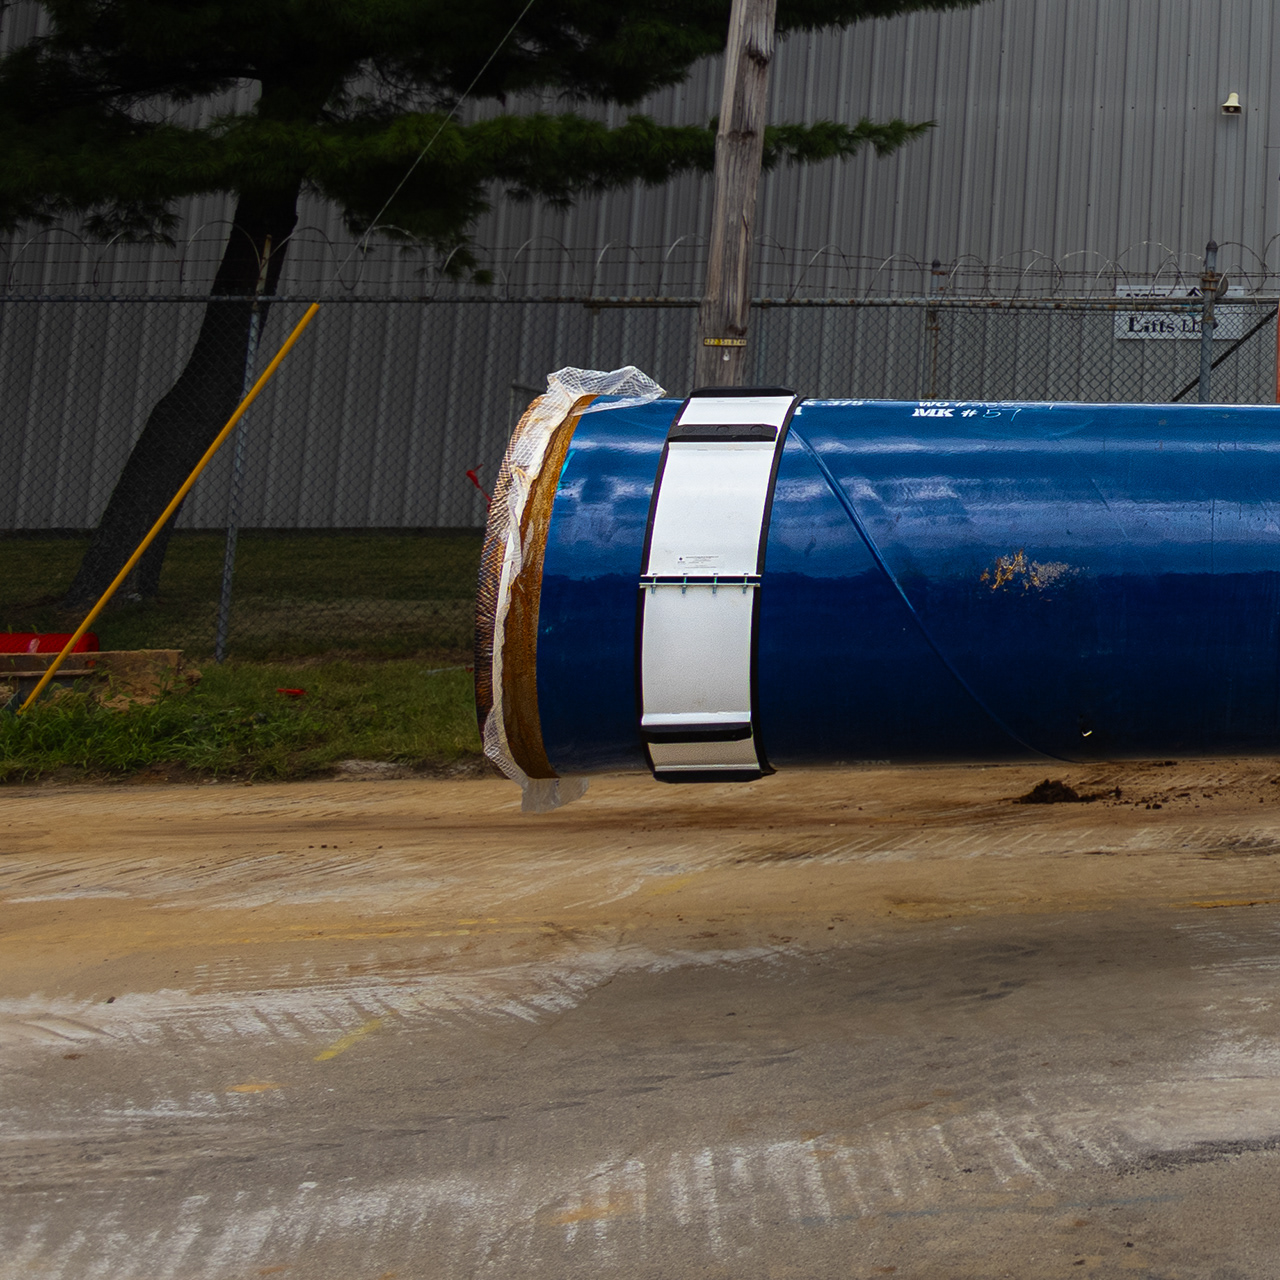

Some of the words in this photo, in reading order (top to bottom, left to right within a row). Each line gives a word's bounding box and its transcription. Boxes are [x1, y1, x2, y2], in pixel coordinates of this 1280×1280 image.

[1127, 316, 1176, 333] Lifts
[912, 408, 956, 418] MK
[960, 408, 979, 419] #
